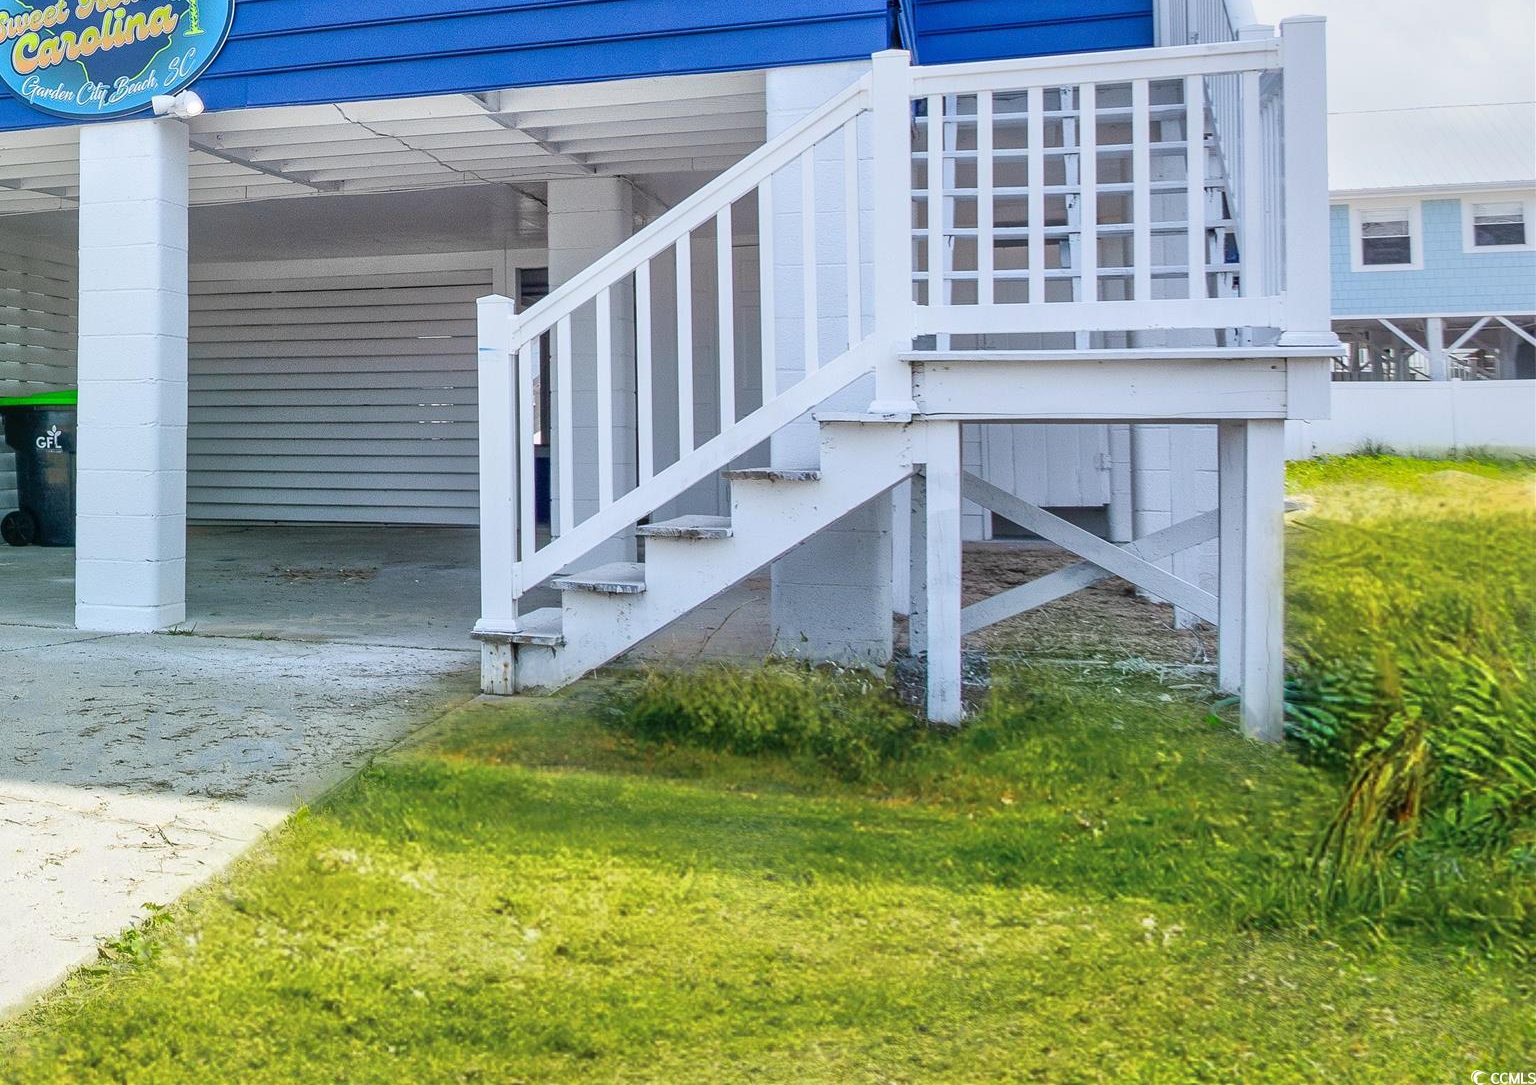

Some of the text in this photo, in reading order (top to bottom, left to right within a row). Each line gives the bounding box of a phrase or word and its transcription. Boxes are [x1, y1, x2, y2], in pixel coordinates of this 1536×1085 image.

[11, 3, 180, 75] Carolina
[21, 47, 196, 110] Garden City Beach, SC
[35, 431, 62, 449] GFL
